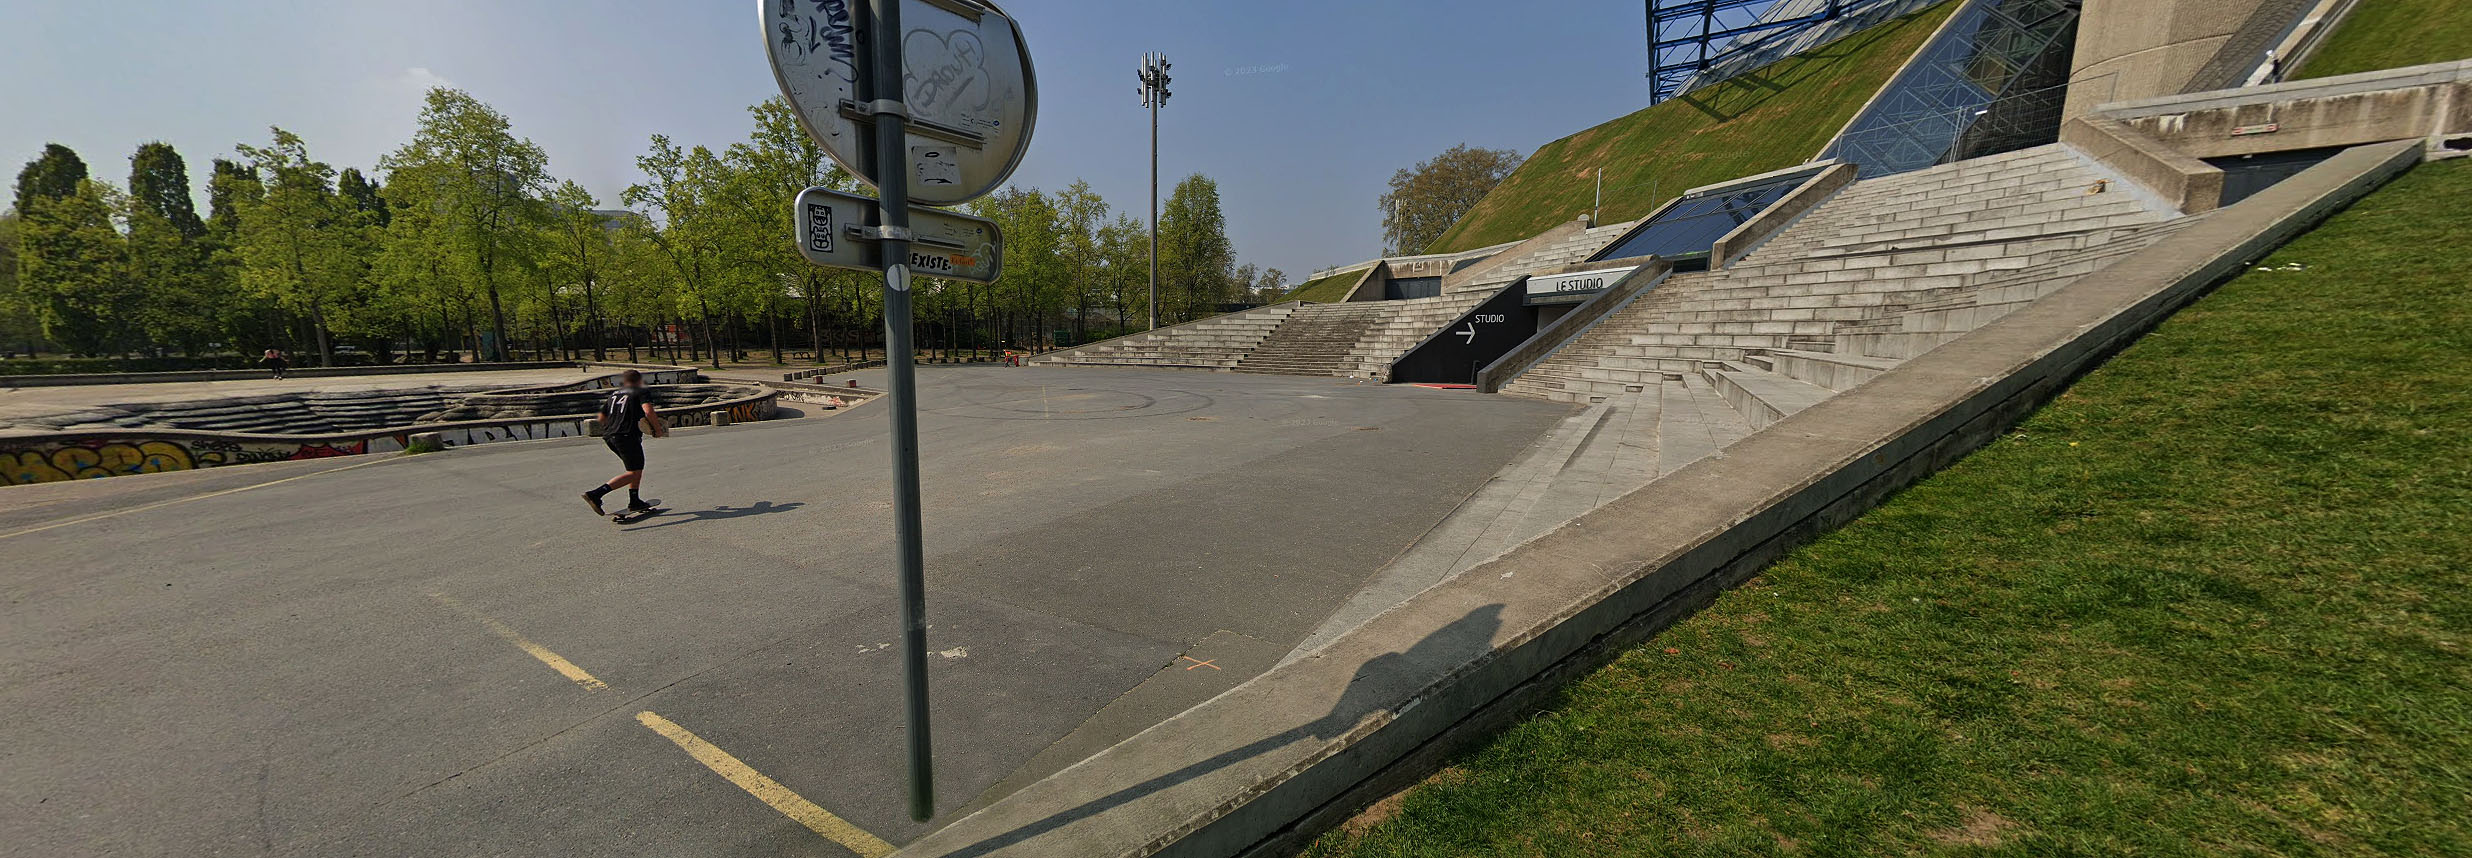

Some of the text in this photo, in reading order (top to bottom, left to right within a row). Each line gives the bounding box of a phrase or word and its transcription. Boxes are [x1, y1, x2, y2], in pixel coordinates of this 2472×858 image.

[909, 252, 952, 271] EXISTE.
[1556, 277, 1604, 291] LE STUDIO
[1475, 314, 1505, 323] STUDIO
[610, 394, 629, 414] 14
